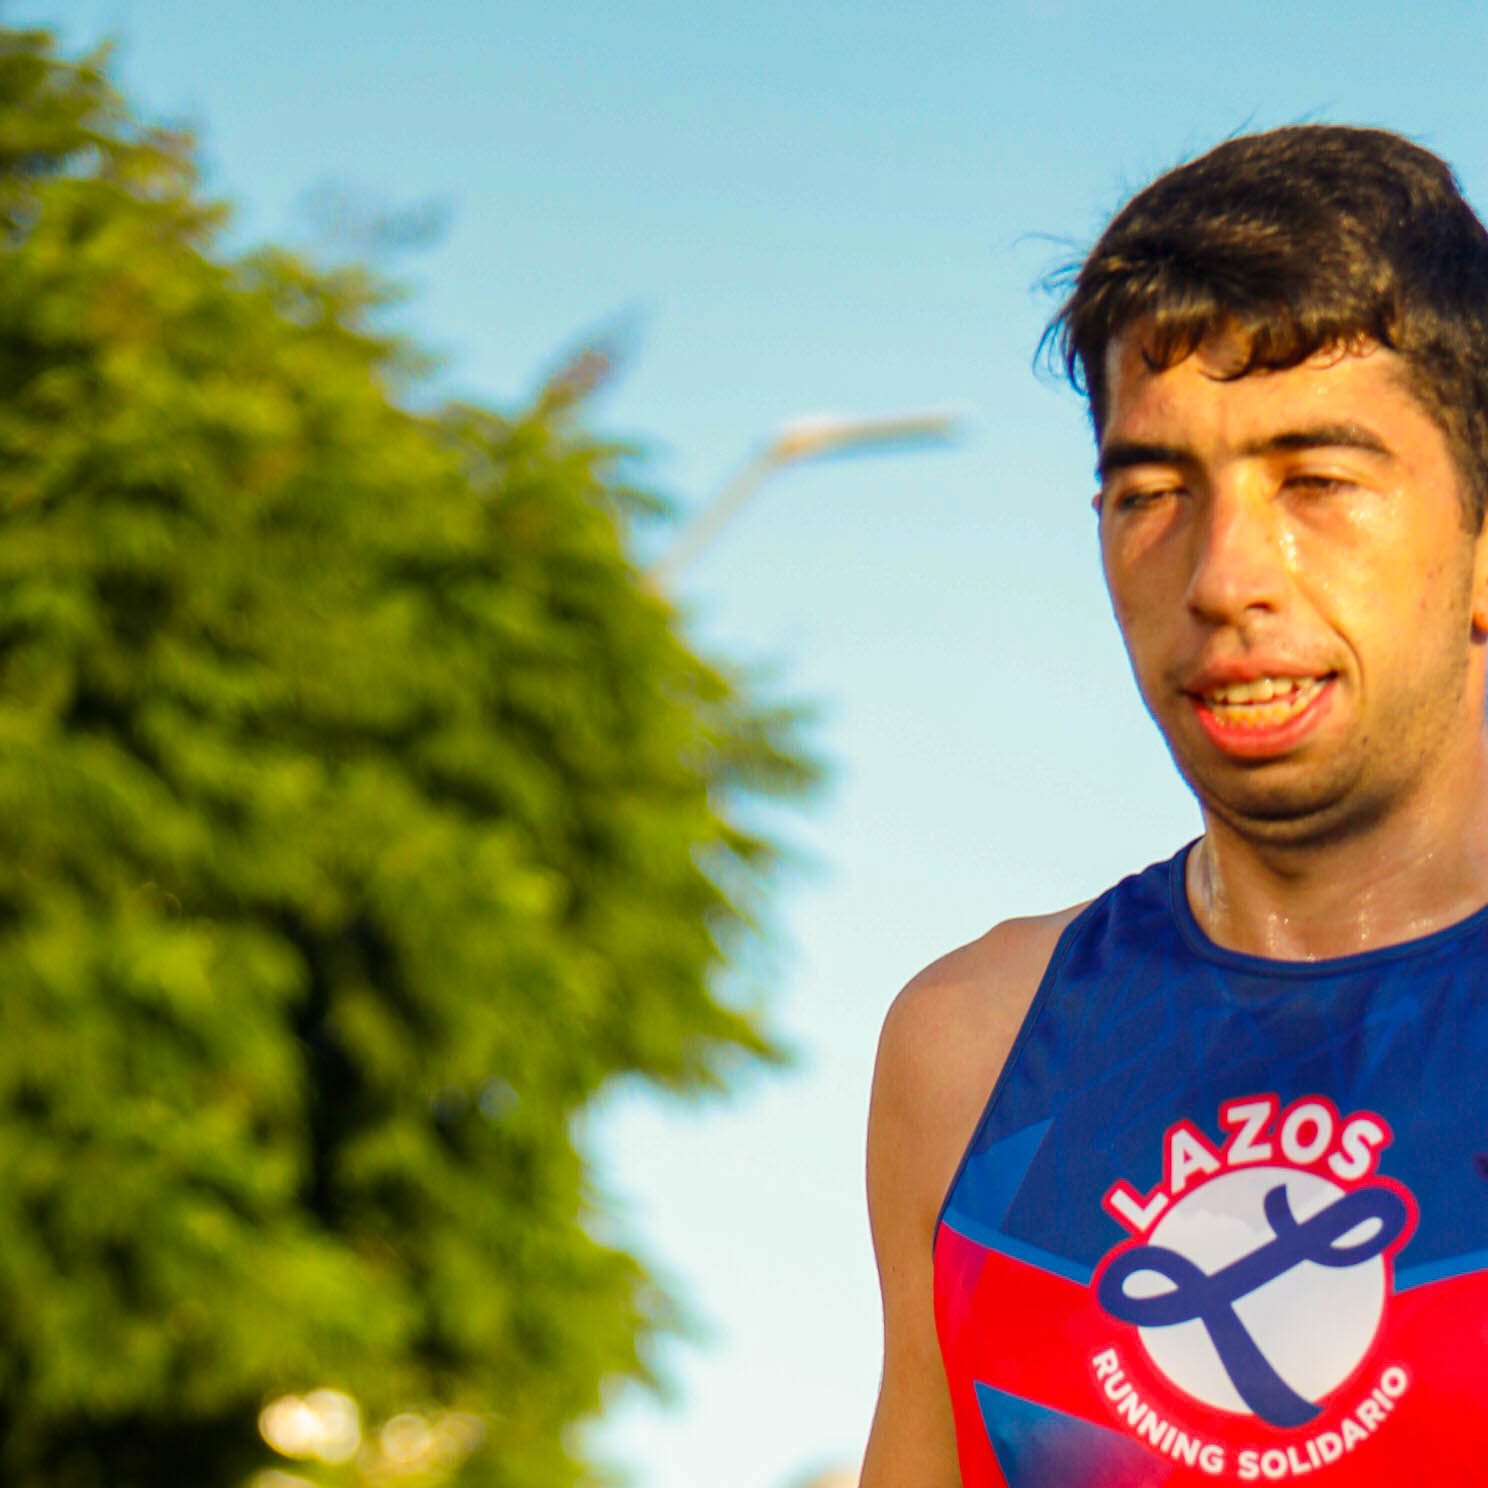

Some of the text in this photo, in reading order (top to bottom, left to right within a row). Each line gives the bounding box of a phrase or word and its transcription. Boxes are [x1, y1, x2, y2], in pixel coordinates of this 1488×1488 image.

[1110, 1100, 1384, 1233] LAZOS
[1092, 1347, 1407, 1480] RUNNING SOLIDARIO
